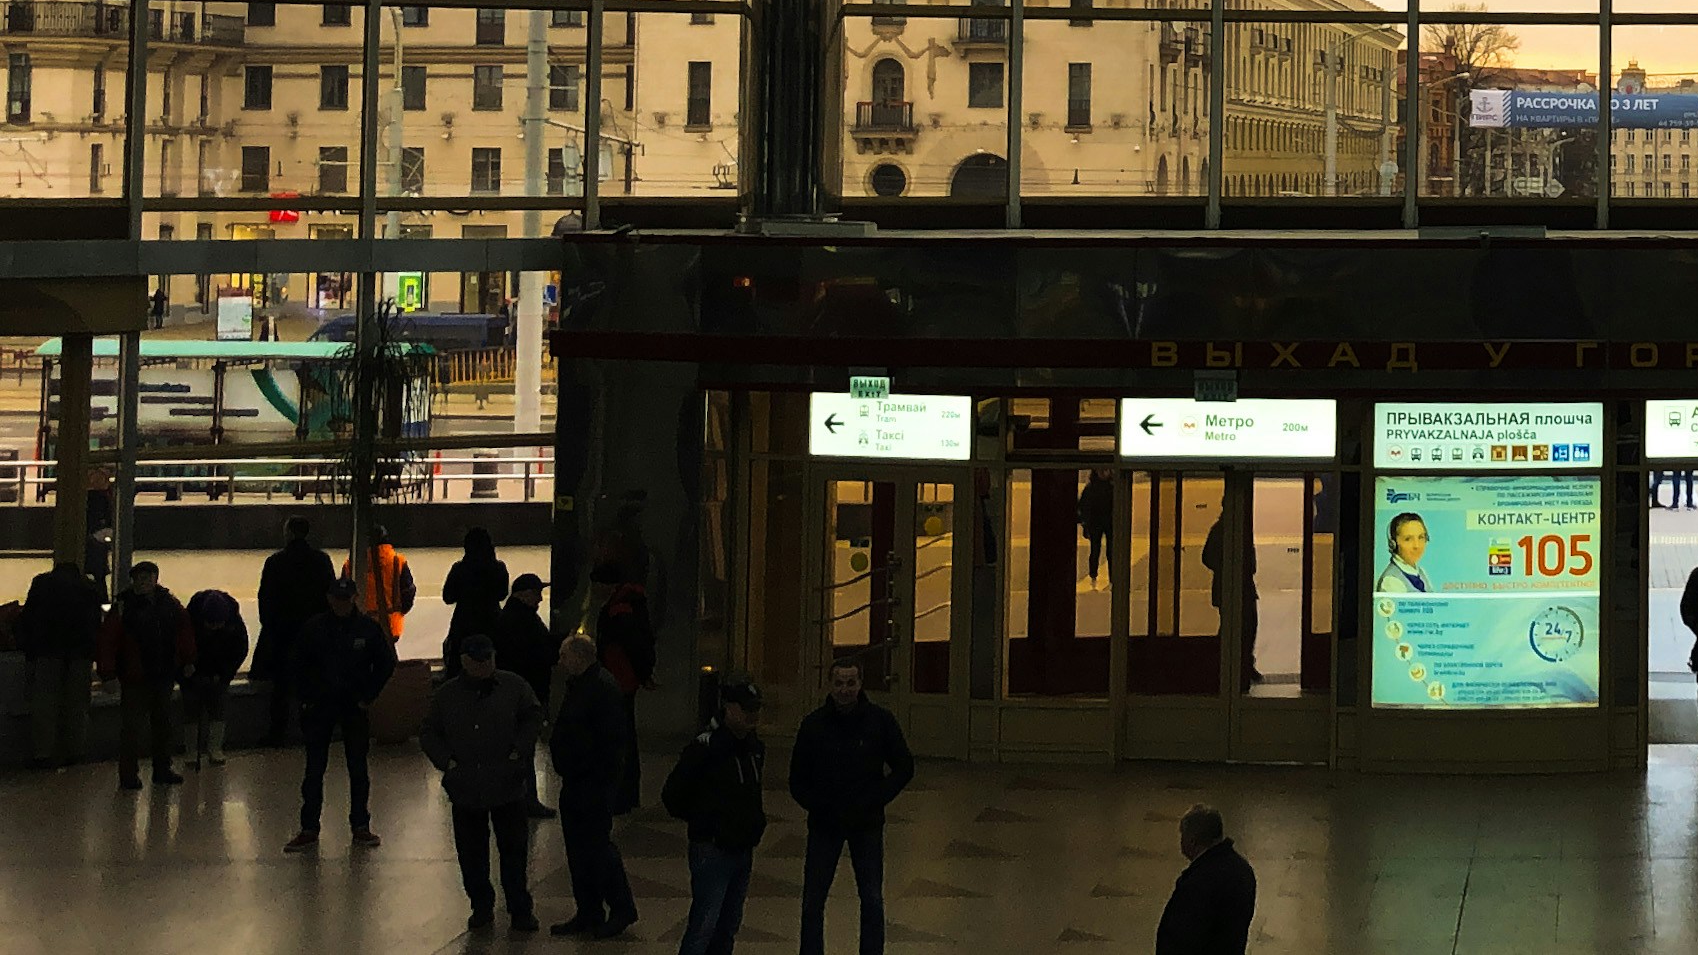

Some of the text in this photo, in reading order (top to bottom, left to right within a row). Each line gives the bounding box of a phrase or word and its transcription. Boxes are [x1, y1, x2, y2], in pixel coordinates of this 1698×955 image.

[1517, 97, 1660, 111] РАССРОЧКА О 3 ЛЕТ
[1149, 342, 1419, 372] ВЫХАД
[1487, 343, 1512, 368] У
[852, 379, 886, 391] ВЫХОД
[876, 400, 927, 414] Трамвай
[876, 415, 897, 423] Tram
[1205, 414, 1309, 432] Метро 200м
[1386, 412, 1592, 426] ПРЫВАКЗАЛЬНАЯ плошча
[875, 429, 904, 440] Таксі
[1205, 431, 1236, 441] Metro
[1386, 428, 1537, 442] PRYVAKZALNAJA plošča
[1477, 511, 1596, 526] КОНТАКТ-ЦЕНТР
[1517, 534, 1594, 577] 105
[1545, 622, 1573, 643] 24/7
